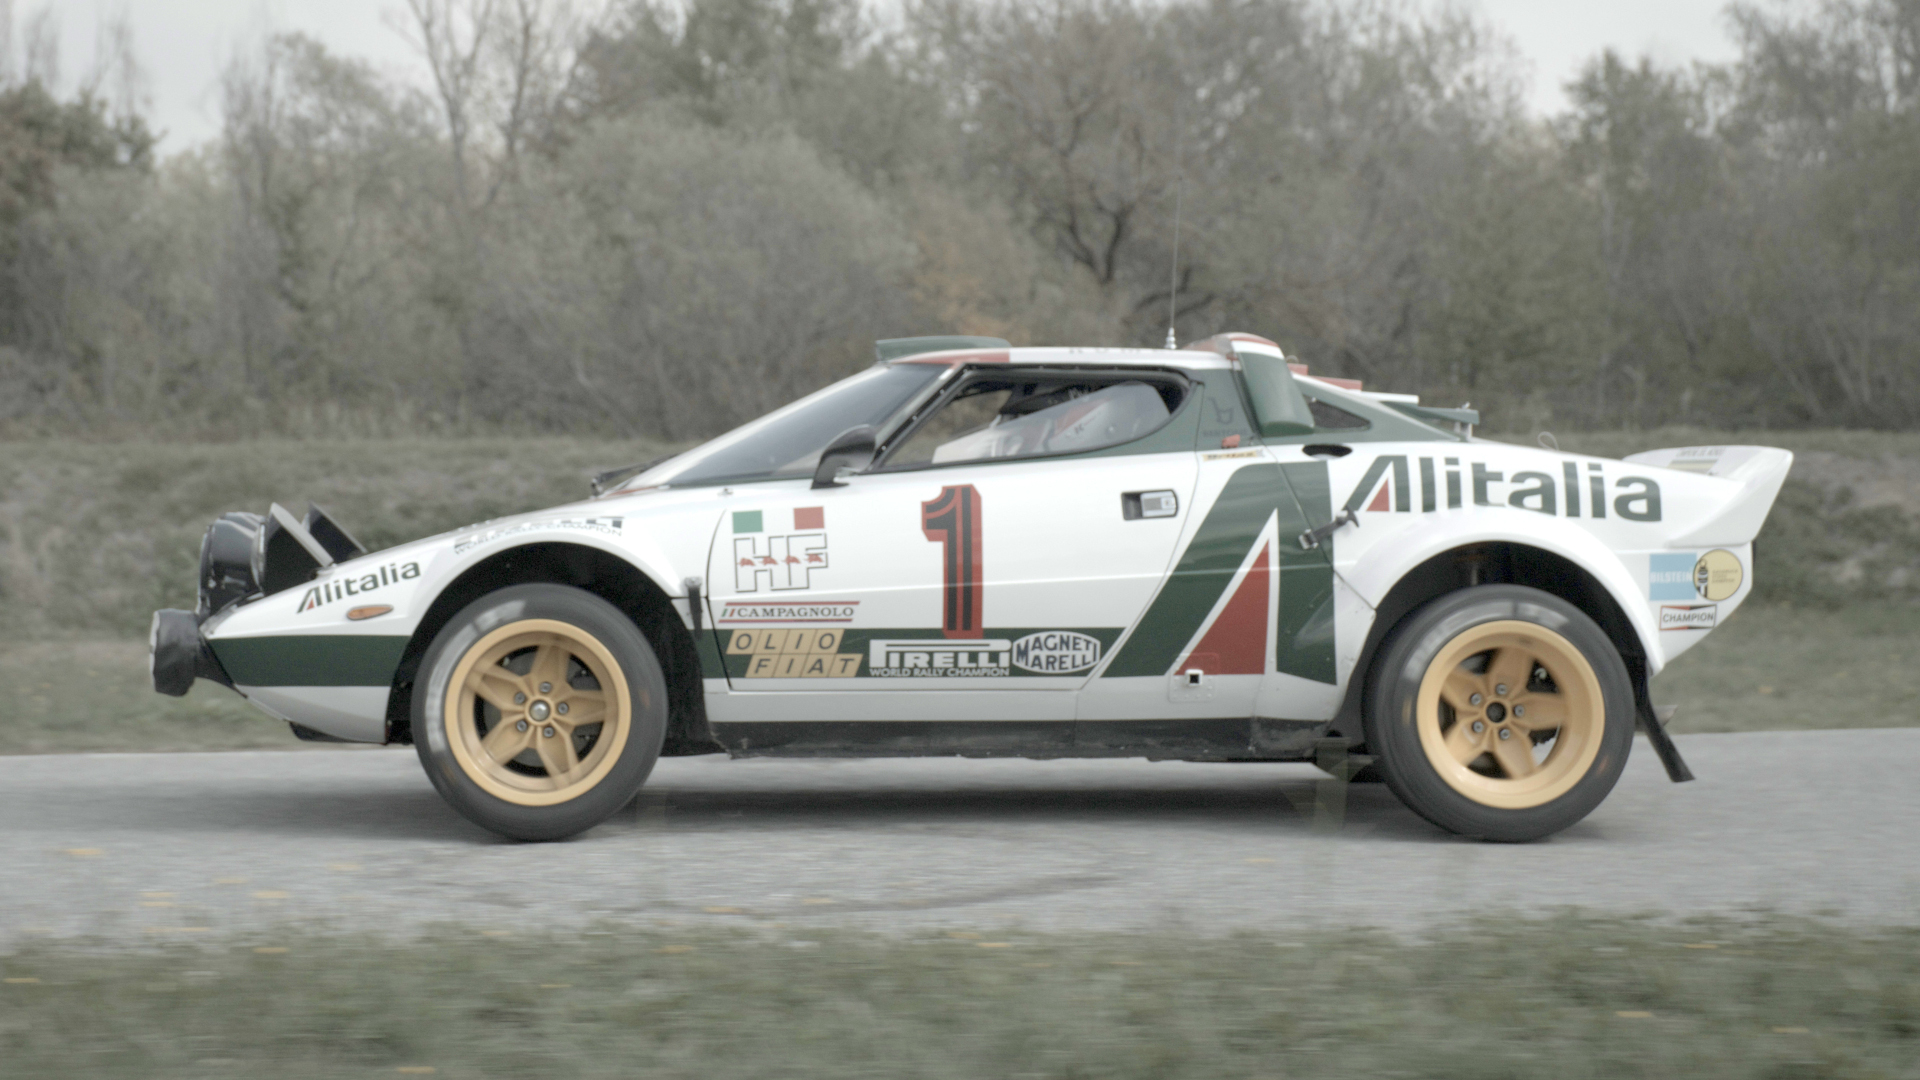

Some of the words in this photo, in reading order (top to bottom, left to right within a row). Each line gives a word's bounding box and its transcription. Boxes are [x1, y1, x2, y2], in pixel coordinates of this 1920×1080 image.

[1341, 455, 1662, 522] Alitalia
[734, 533, 828, 593] HF
[921, 484, 984, 639] 1
[297, 561, 421, 614] Alitalia
[737, 607, 854, 618] CAMPAGNOLO
[1662, 613, 1714, 623] CHAMPION
[736, 633, 835, 650] OLIO
[1016, 634, 1097, 657] MAGNETI
[869, 639, 1012, 668] PIRELLI
[1016, 648, 1097, 671] MARELLI
[755, 658, 855, 674] FIAT
[869, 667, 911, 677] WORLD
[913, 667, 944, 677] RALLY
[946, 667, 1010, 677] CHAMPION
